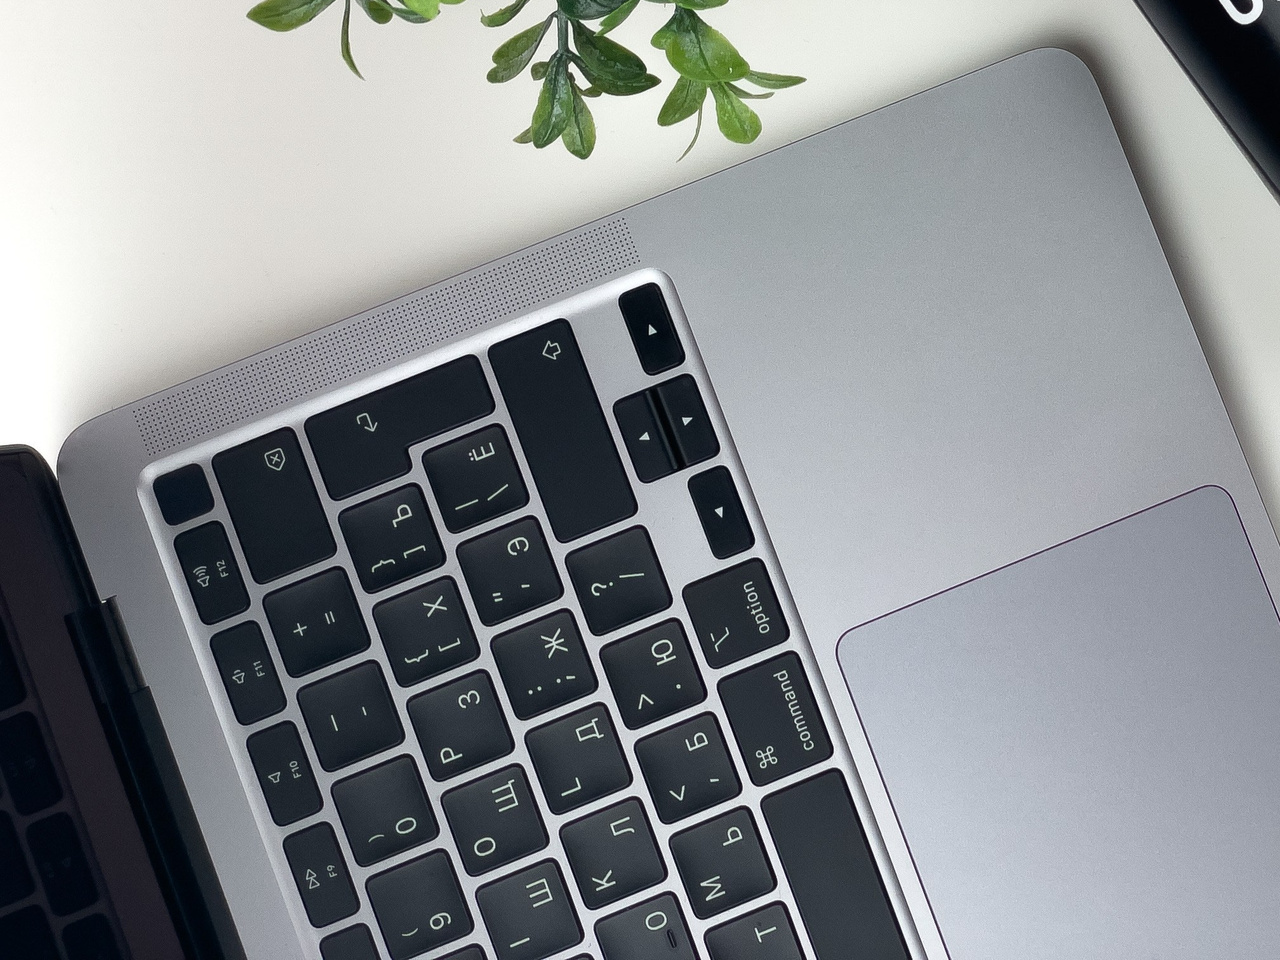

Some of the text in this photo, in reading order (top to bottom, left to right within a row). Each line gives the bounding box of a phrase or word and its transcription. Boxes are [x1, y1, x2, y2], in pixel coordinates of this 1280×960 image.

[216, 559, 229, 578] F12
[743, 581, 770, 634] option
[253, 660, 266, 677] F11
[773, 670, 815, 751] command
[440, 747, 463, 764] P
[289, 760, 302, 779] F10
[561, 777, 582, 797] L
[395, 817, 417, 835] 0
[326, 864, 338, 878] F9
[591, 869, 617, 892] K
[699, 875, 726, 902] M
[429, 912, 452, 930] 9
